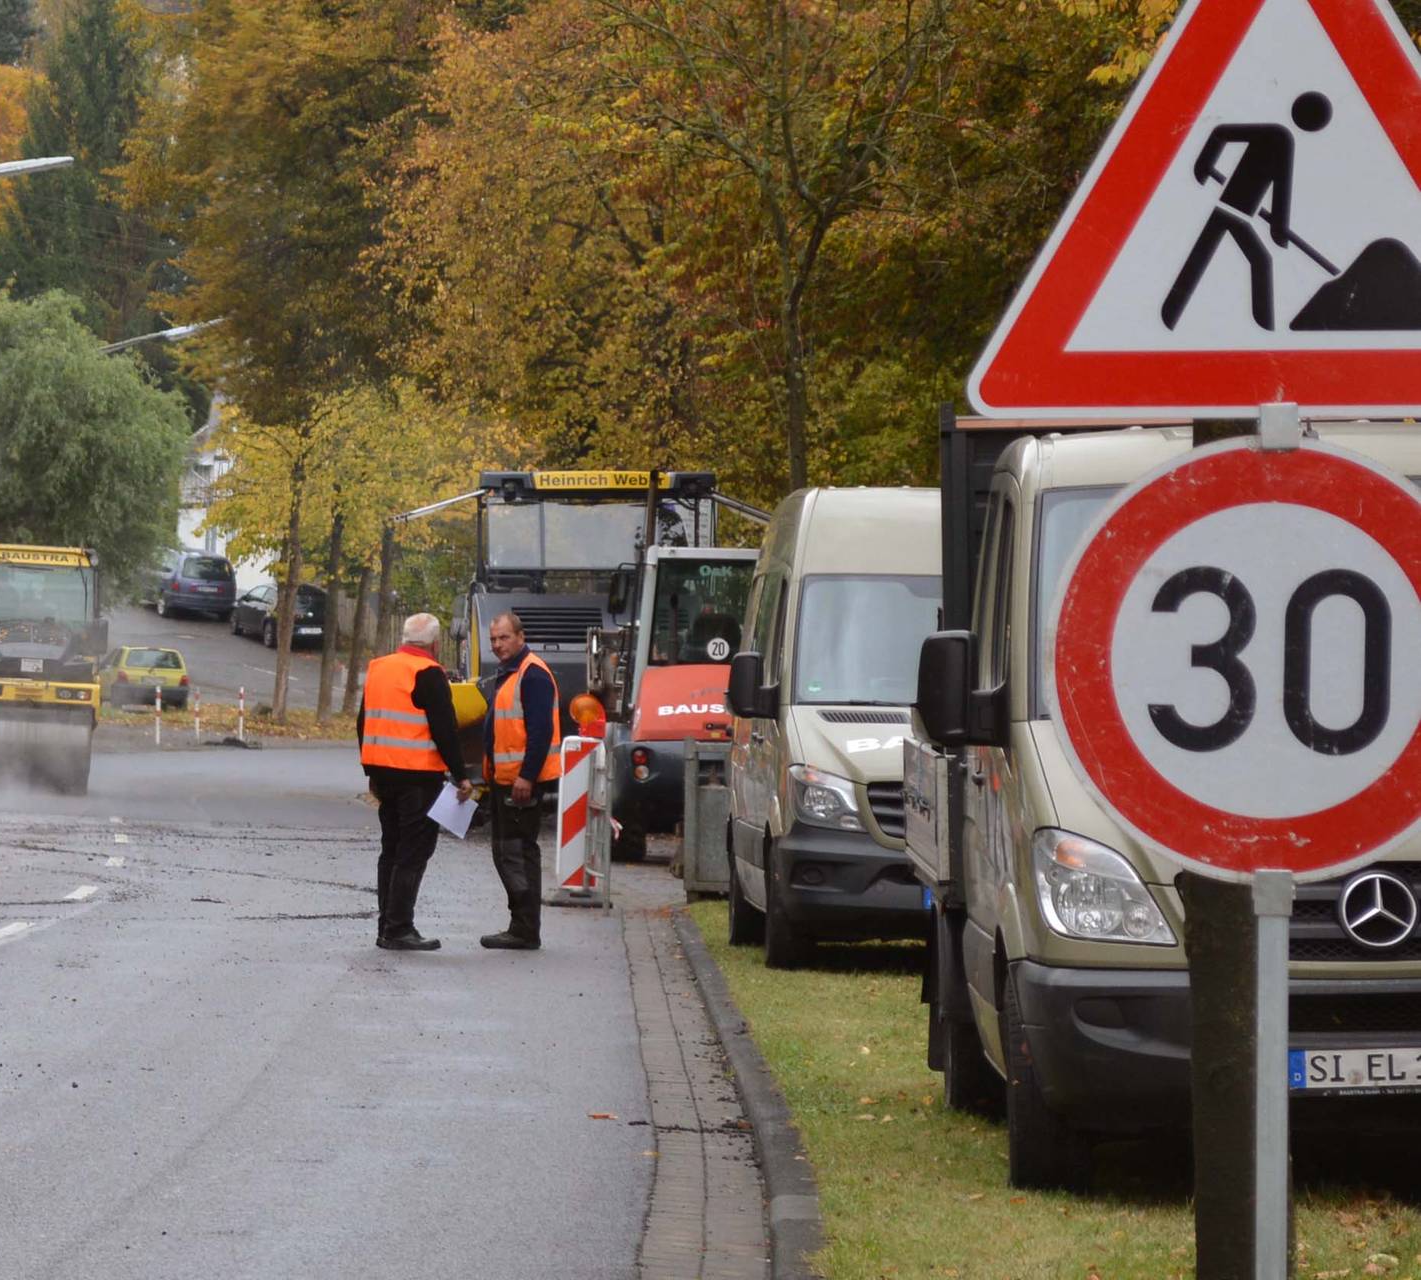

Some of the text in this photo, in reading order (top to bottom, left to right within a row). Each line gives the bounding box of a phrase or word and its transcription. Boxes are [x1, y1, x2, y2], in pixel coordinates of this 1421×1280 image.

[539, 473, 665, 486] Heinrich Webr
[1, 552, 69, 562] BAUSTRA
[712, 641, 725, 656] 20
[1147, 565, 1393, 756] 30
[658, 704, 727, 716] BAUS
[1310, 1055, 1345, 1082] SI
[1367, 1054, 1406, 1081] EL
